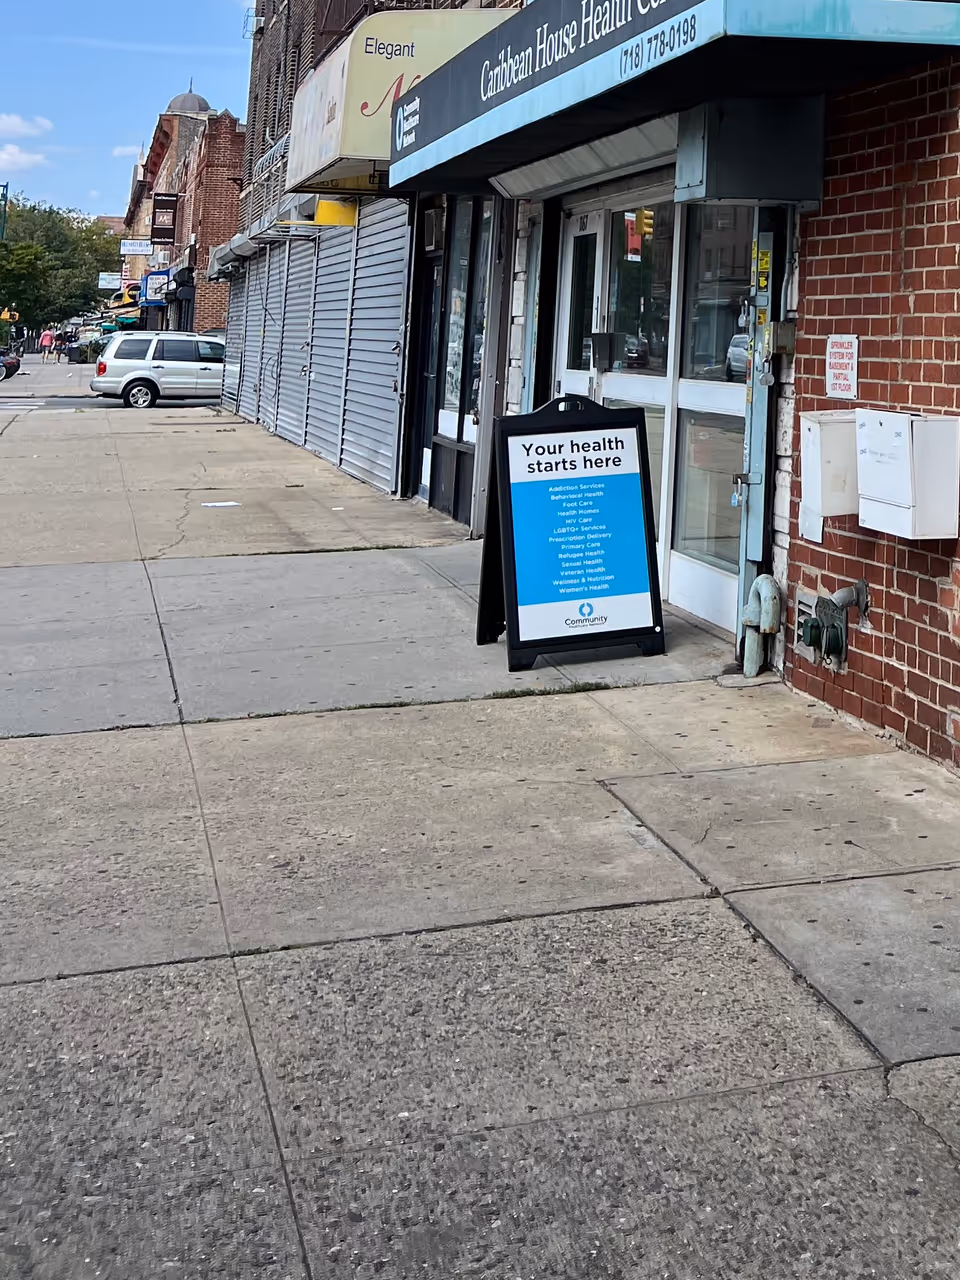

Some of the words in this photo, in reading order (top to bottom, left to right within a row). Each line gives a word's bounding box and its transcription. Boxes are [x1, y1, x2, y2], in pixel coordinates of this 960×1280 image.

[365, 37, 415, 59] Elegant
[619, 37, 644, 80] (718)
[647, 14, 697, 62] 778-0198
[480, 43, 533, 102] Caribbean
[536, 23, 577, 72] House
[831, 341, 852, 349] SPRINKLER
[845, 352, 854, 360] FOR
[829, 362, 850, 370] BASEMENT
[833, 372, 849, 381] PARTIAL
[838, 383, 851, 392] FLOOR
[522, 441, 564, 456] Your
[570, 437, 625, 453] health
[527, 457, 576, 473] starts
[583, 454, 622, 468] here
[549, 535, 585, 543] Prescription
[587, 532, 612, 540] Delivery
[553, 577, 580, 585] Wellness
[559, 585, 588, 593] Women's
[565, 615, 608, 626] Community
